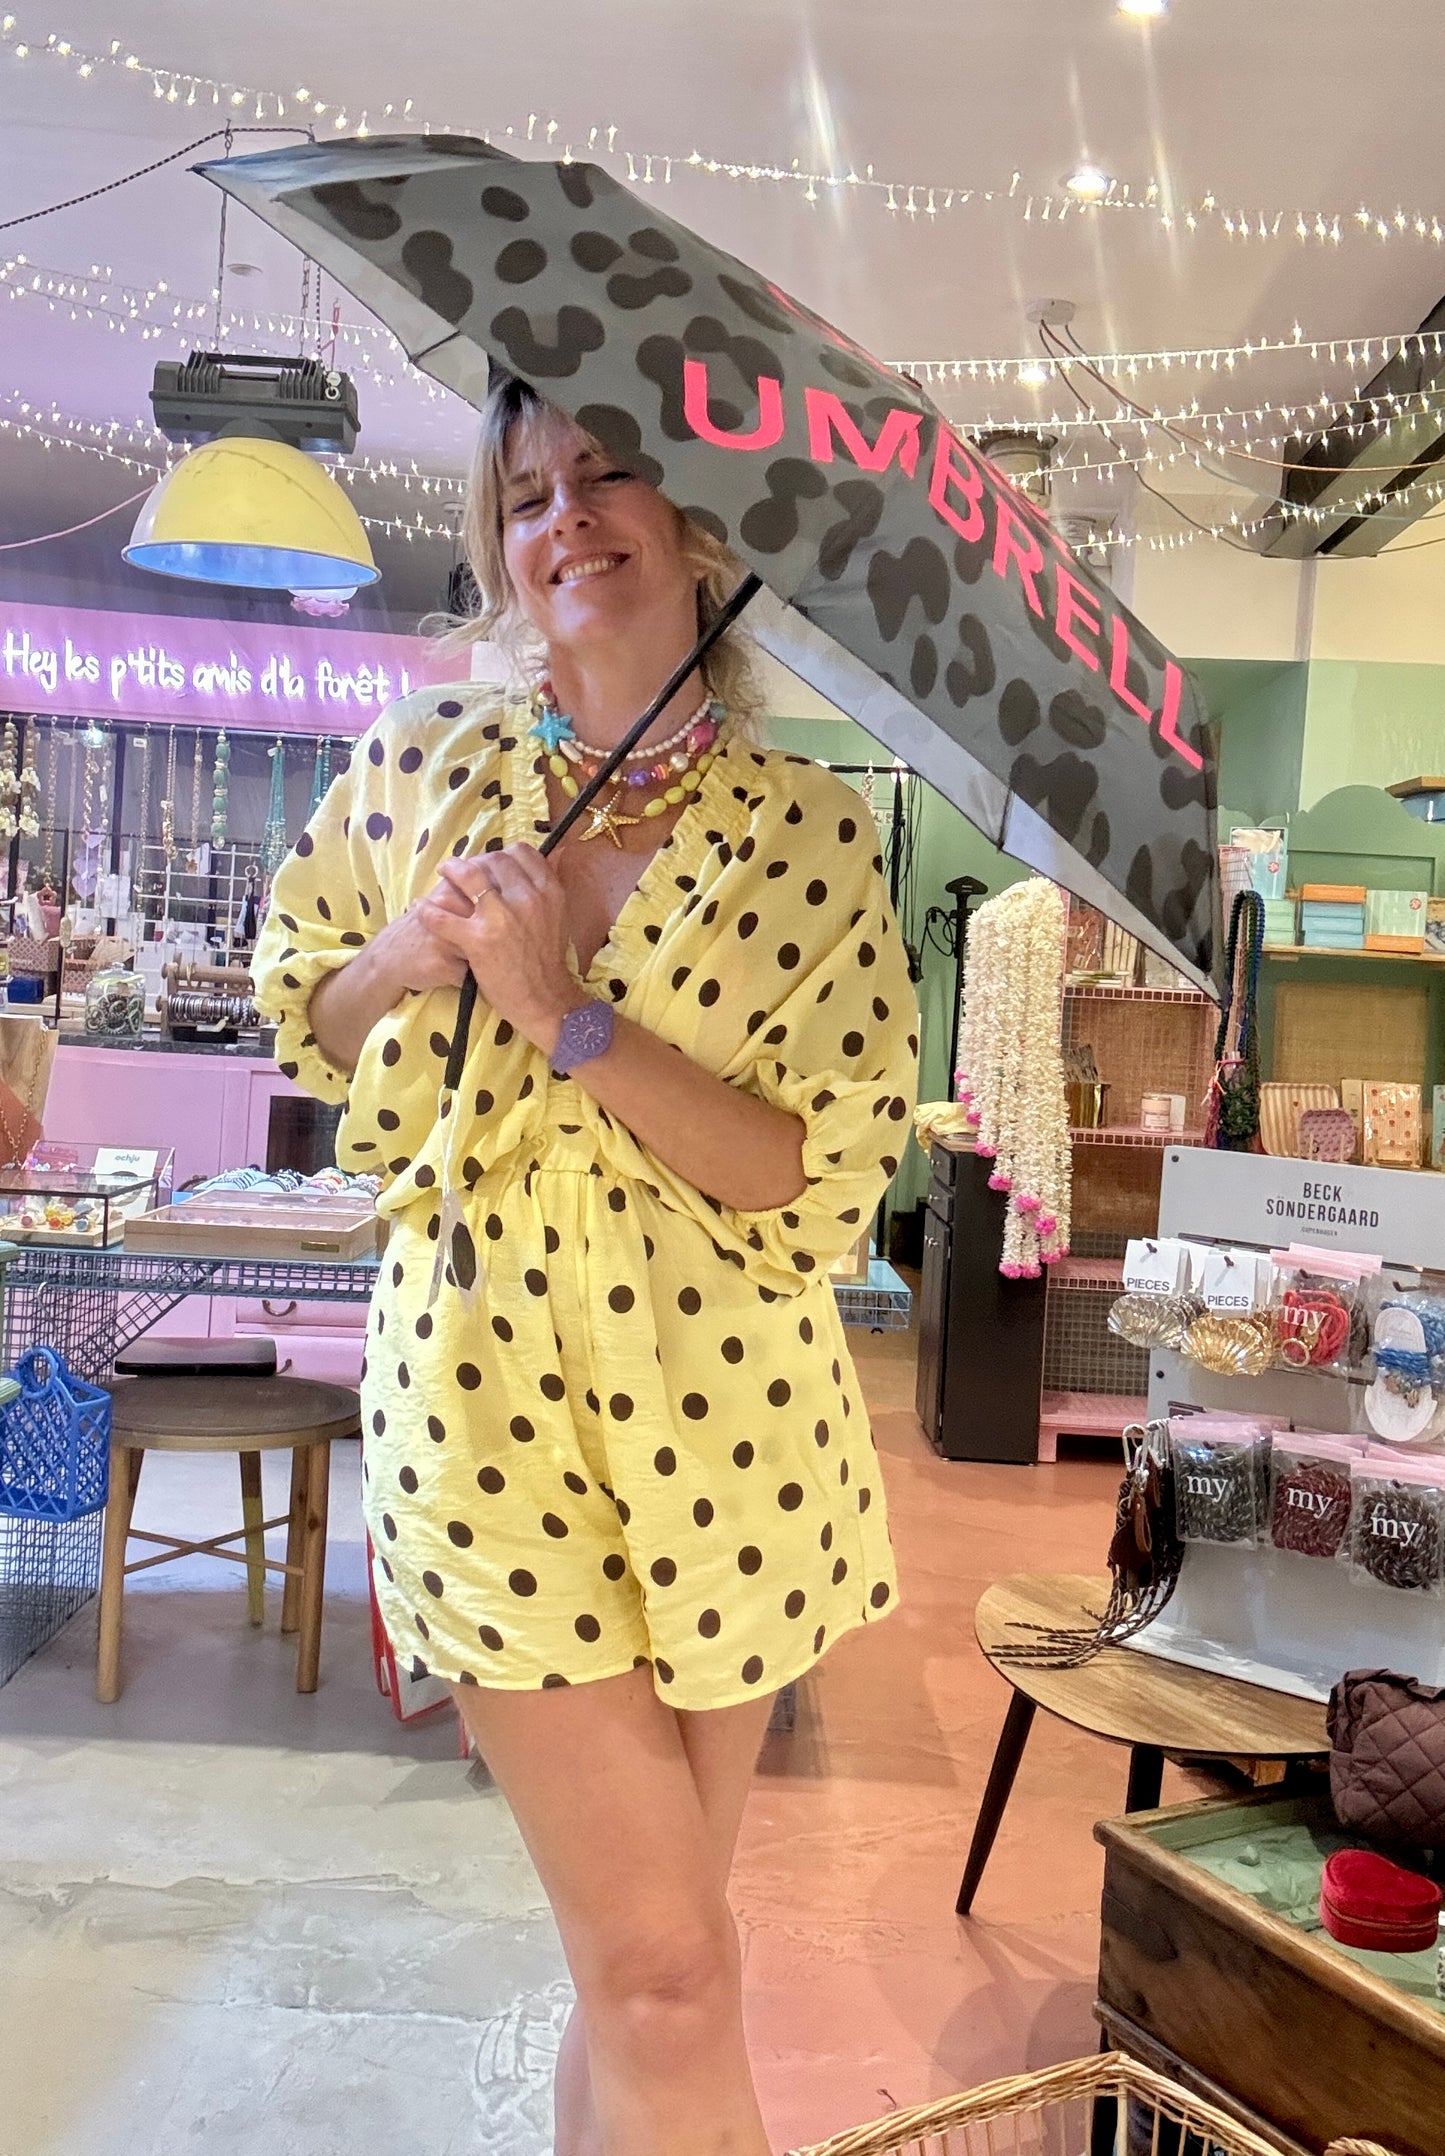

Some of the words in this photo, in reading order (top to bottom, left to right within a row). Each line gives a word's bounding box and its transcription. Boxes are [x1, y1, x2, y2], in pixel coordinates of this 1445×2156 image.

[3, 632, 57, 692] Hey
[65, 639, 100, 680] les
[110, 647, 186, 699] p'tits
[193, 652, 252, 693] amis
[261, 656, 304, 699] d'la
[316, 661, 389, 702] forêt
[1303, 1182, 1342, 1202] BECK
[1266, 1195, 1379, 1228] SÖNDERGAARD
[1126, 1277, 1170, 1292] PIECES
[1207, 1294, 1249, 1308] PIECES
[1283, 1303, 1326, 1333] my
[1187, 1475, 1229, 1502] my
[1287, 1487, 1333, 1519] my
[1370, 1513, 1419, 1546] my
